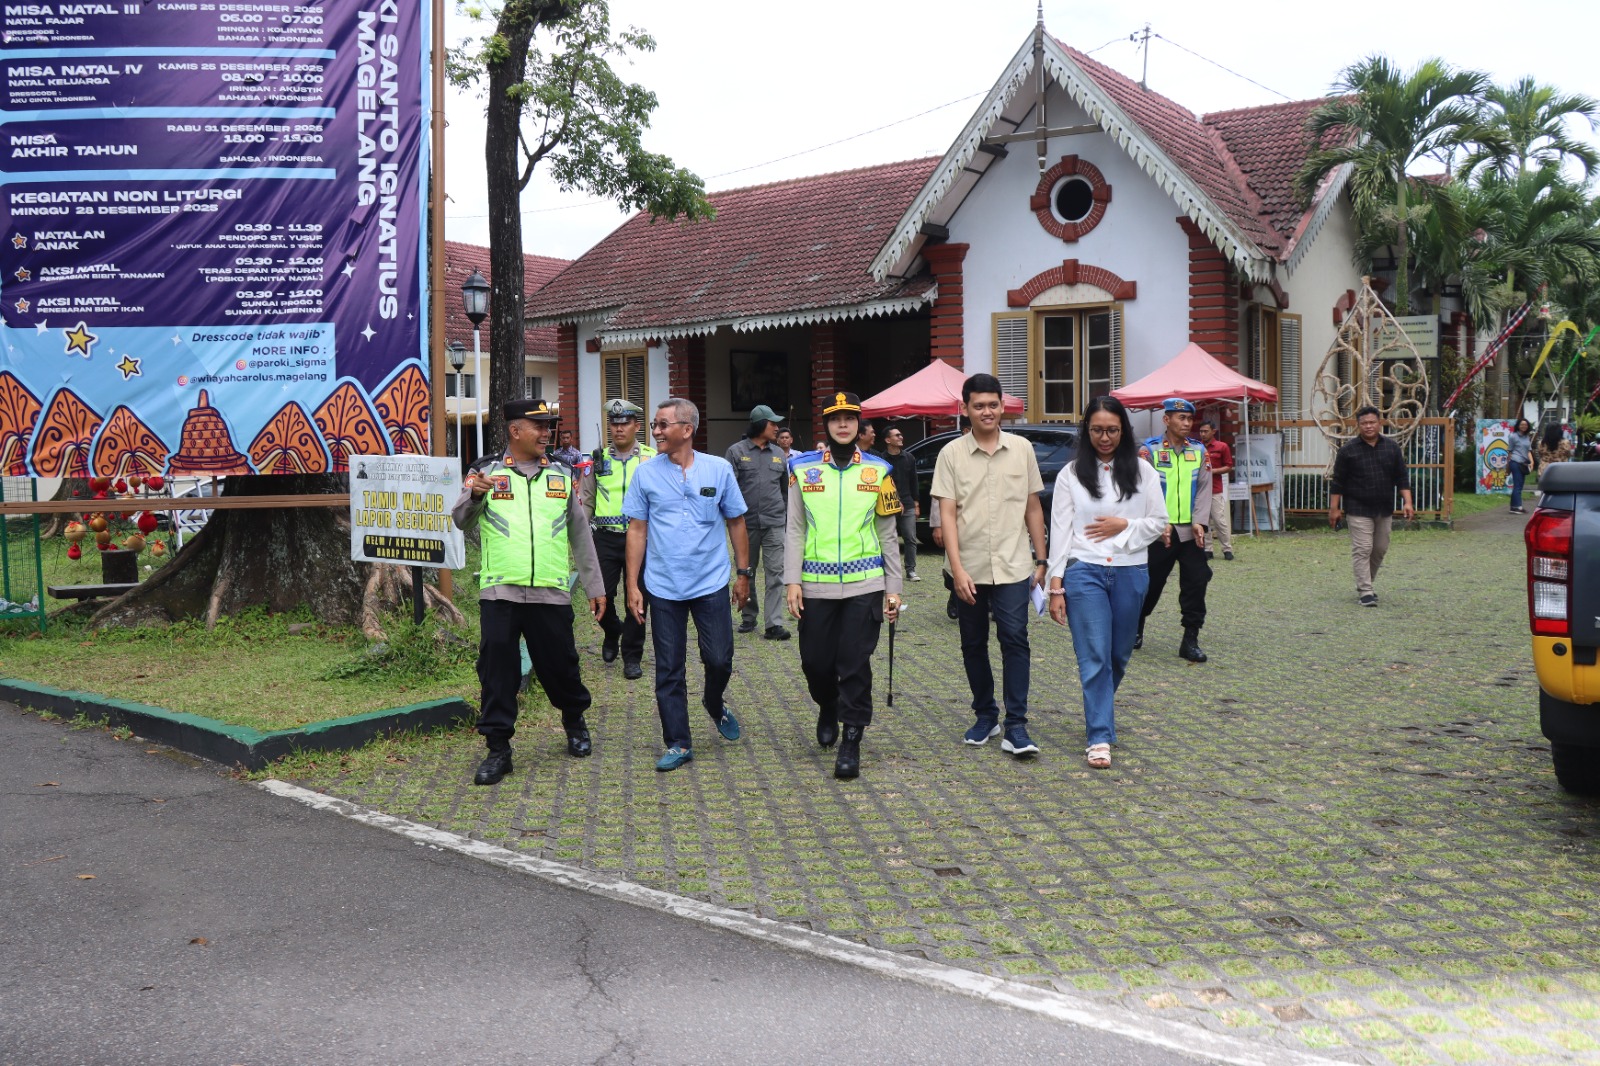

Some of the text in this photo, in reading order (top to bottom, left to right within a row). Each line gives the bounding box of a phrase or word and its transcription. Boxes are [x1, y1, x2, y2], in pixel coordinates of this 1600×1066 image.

[5, 4, 140, 15] MISA NATAL III
[220, 14, 262, 22] 06.00
[282, 16, 323, 24] 07.00
[8, 65, 143, 77] MISA NATAL IV
[283, 74, 324, 83] 10.00
[380, 34, 398, 152] SANTO
[358, 11, 376, 206] MAGELANG
[11, 135, 57, 145] MISA
[224, 134, 264, 143] 18.00
[12, 145, 137, 158] AKHIR TAHUN
[11, 189, 242, 203] KEGIATAN NON LITURGI
[11, 207, 70, 215] MINGGU
[98, 205, 180, 214] DESEMBER
[34, 231, 105, 240] NATALAN
[35, 242, 79, 250] ANAK
[378, 163, 398, 319] IGNATIUS
[77, 264, 120, 272] NATAL
[289, 290, 323, 298] 12.00
[74, 297, 120, 305] NATAL
[192, 333, 253, 342] Dresscode
[257, 330, 285, 340] tidak
[252, 347, 286, 355] MORE
[290, 346, 319, 354] INFO
[249, 358, 326, 368] @paroki_sigma
[363, 491, 444, 512] TAMU WAJIB
[356, 510, 452, 532] LAPOR SECURITY
[396, 538, 414, 548] KACA
[418, 540, 442, 550] MOBIL
[377, 548, 431, 561] HARAP DIBUKA
